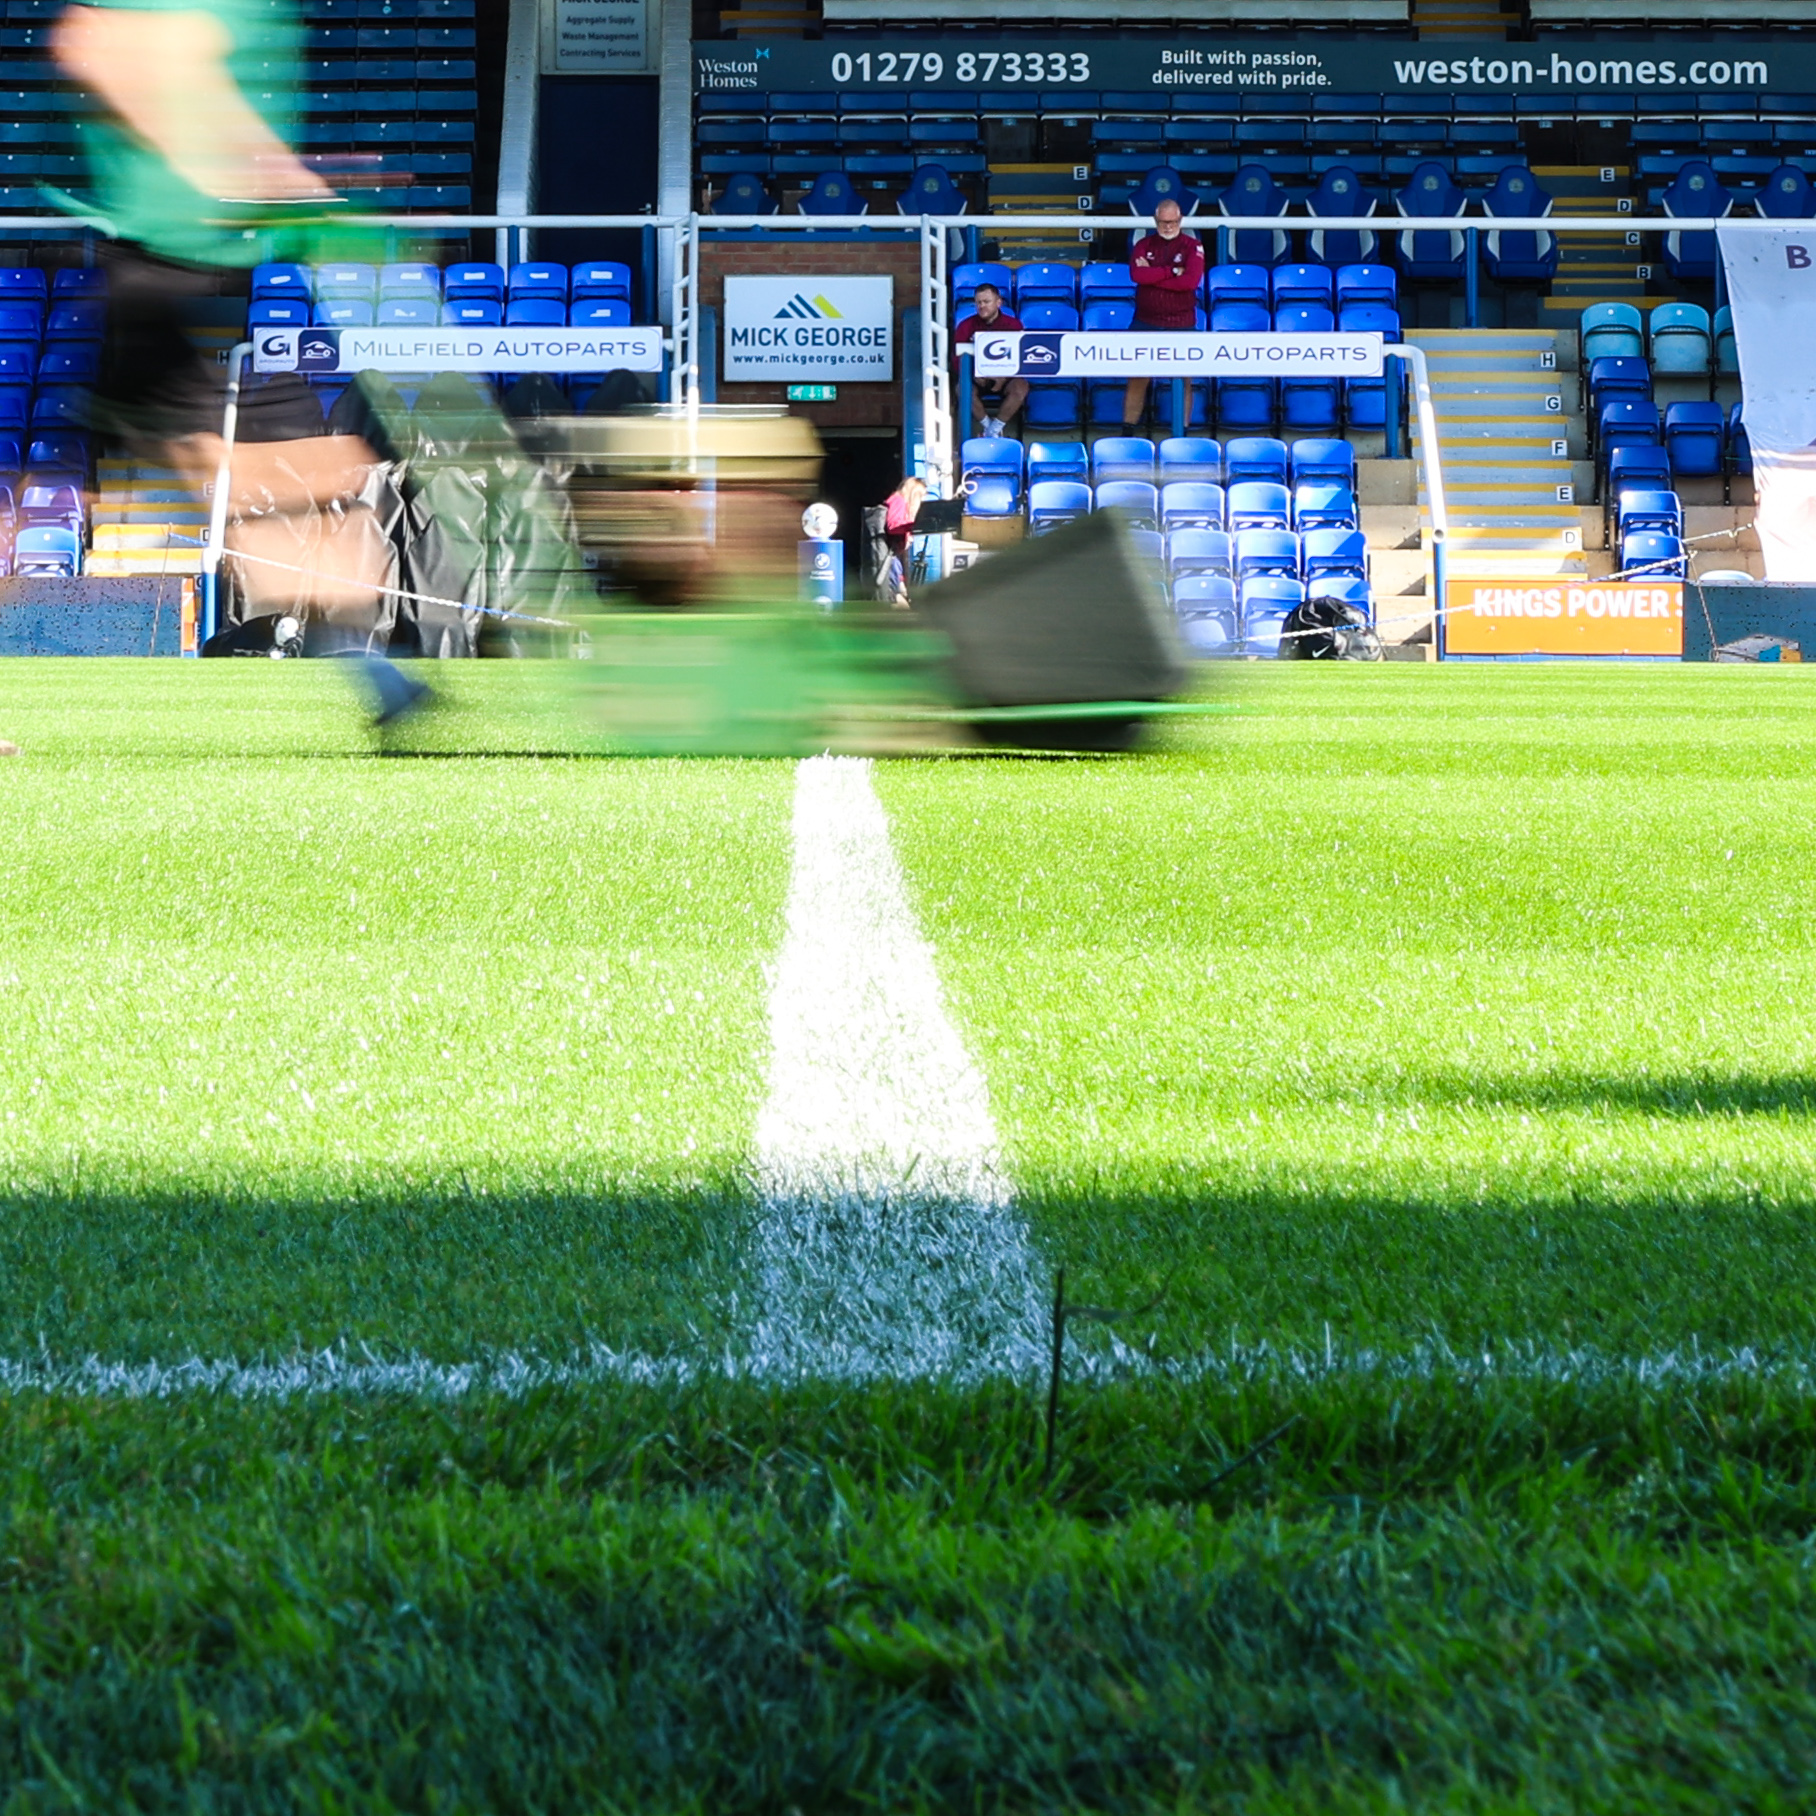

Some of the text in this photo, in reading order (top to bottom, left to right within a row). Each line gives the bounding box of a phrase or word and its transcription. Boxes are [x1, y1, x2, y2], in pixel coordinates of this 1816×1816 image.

[566, 15, 635, 25] Aggregate Supply
[588, 33, 639, 42] Management
[560, 48, 641, 58] Contracting Services
[1162, 50, 1323, 69] Built with passion,
[698, 59, 758, 73] Weston
[831, 52, 1091, 83] 01279 873333
[1394, 53, 1768, 85] weston-homes.com
[699, 73, 757, 88] Homes
[1152, 70, 1332, 89] delivered with pride.
[1076, 168, 1085, 178] E
[1603, 169, 1612, 180] E
[1080, 197, 1089, 209] D
[1619, 200, 1629, 211] D
[1081, 229, 1091, 240] C
[1628, 233, 1638, 243] C
[1639, 267, 1649, 278] B
[731, 327, 887, 346] MICK GEORGE
[353, 340, 647, 357] MILLFIELD AUTOPARTS
[1075, 345, 1368, 361] MILLFIELD AUTOPARTS
[733, 353, 885, 366] www.mickgeorge.co.uk
[1542, 354, 1554, 367] H
[1547, 397, 1559, 410] G
[1555, 442, 1564, 454] F
[1559, 487, 1569, 500] E
[1565, 532, 1575, 544] D
[1474, 588, 1563, 618] KINGS
[1568, 588, 1670, 619] POWER
